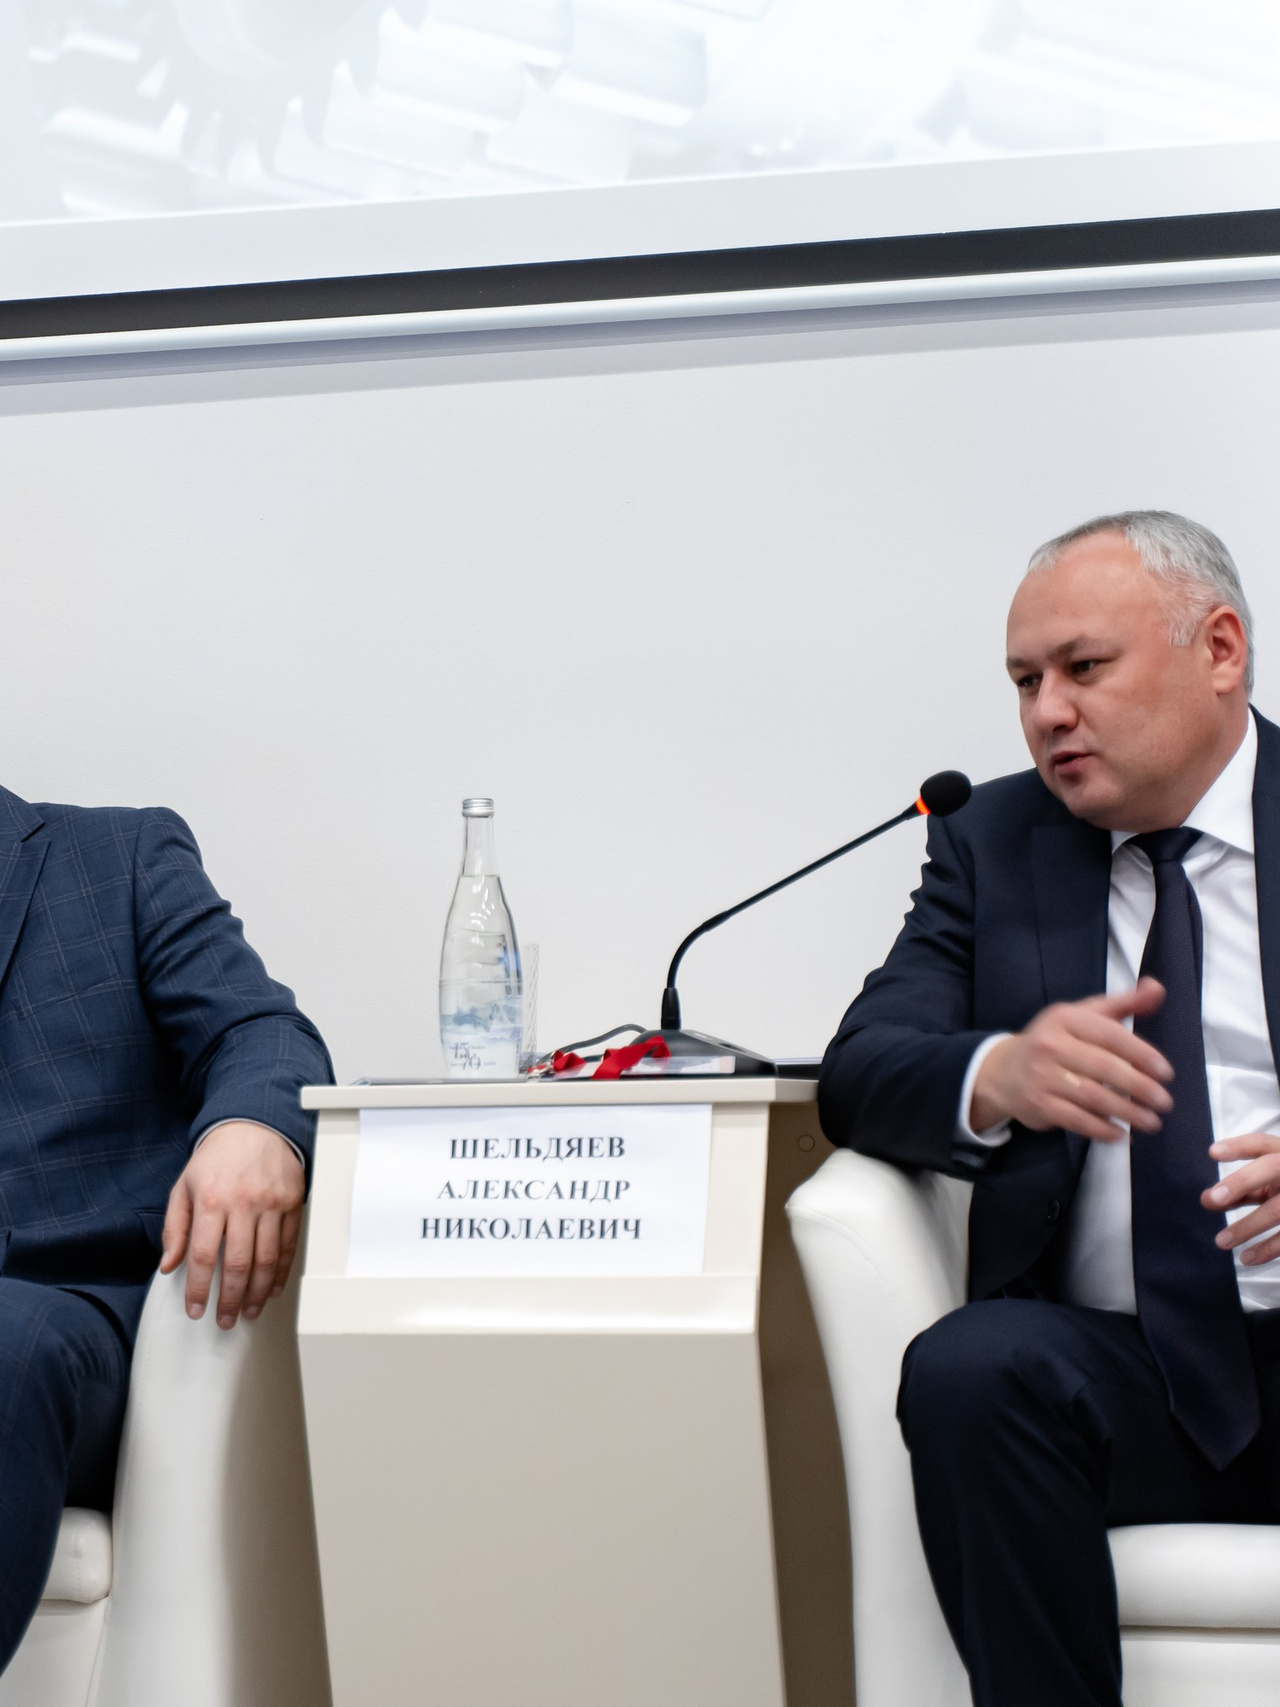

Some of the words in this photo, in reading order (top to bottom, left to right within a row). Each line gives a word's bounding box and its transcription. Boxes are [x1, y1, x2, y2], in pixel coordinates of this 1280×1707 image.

[449, 1136, 626, 1162] ШЕЛЬДЯЕВ
[436, 1179, 631, 1204] АЛЕКСАНДР
[420, 1217, 643, 1240] НИКОЛАЕВИЧ
